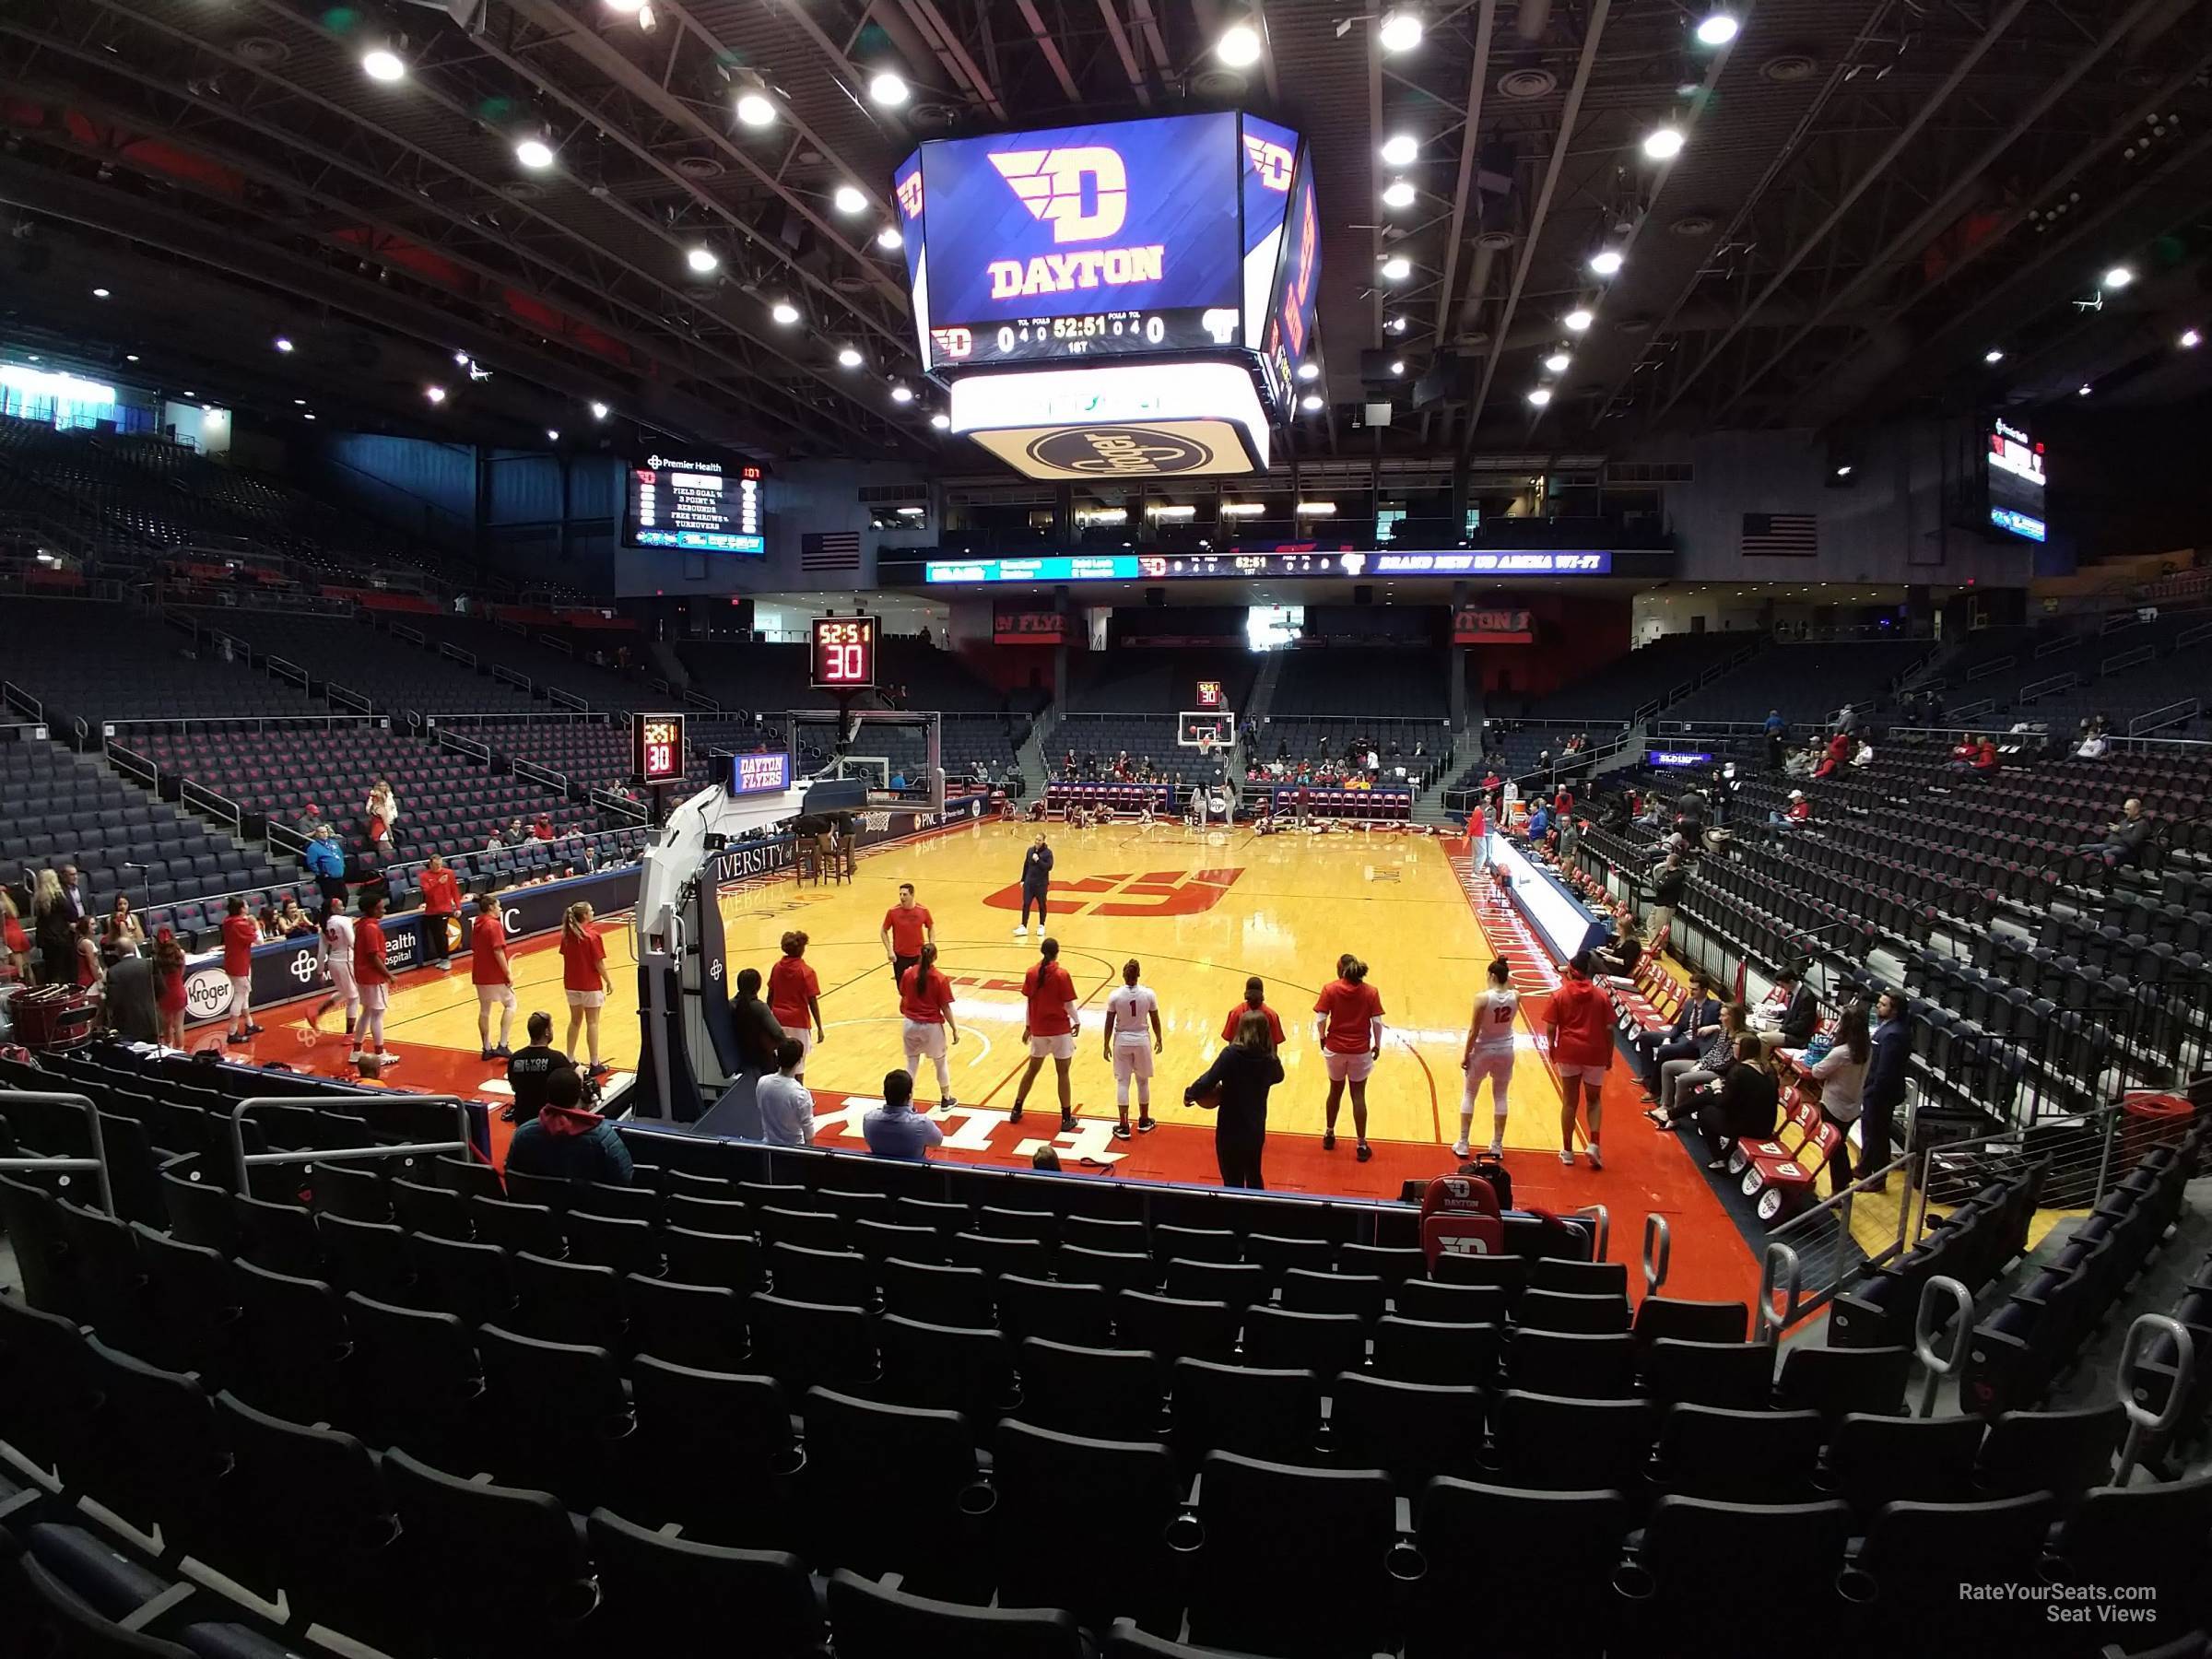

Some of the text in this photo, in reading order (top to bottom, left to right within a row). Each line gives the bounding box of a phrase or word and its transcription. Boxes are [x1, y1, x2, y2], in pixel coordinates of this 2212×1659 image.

[987, 147, 1126, 242] D
[987, 245, 1165, 300] DAYTON
[998, 327, 1015, 353] 0
[1019, 328, 1029, 342] 4
[1037, 326, 1047, 341] 0
[1053, 316, 1106, 338] 52:51
[1112, 321, 1123, 335] 0
[1130, 320, 1140, 335] 4
[1147, 317, 1165, 343] 0
[1068, 342, 1088, 353] 1ST
[663, 459, 722, 472] Premier Health
[673, 488, 695, 496] FIELD
[696, 488, 716, 498] GOAL
[677, 504, 717, 512] REBOUNDS
[671, 512, 691, 520] FREE
[692, 513, 724, 522] THROWS
[675, 521, 720, 530] TURNOVERS
[1208, 563, 1215, 572] 0
[1287, 561, 1293, 571] 0
[1378, 556, 1433, 570] BRAND
[1433, 556, 1473, 570] NEW
[1498, 555, 1553, 569] ARENA
[819, 624, 869, 643] 52:51
[827, 645, 862, 677] 30
[1202, 691, 1215, 702] 30
[650, 746, 669, 771] 30
[740, 757, 782, 773] DAYTON
[742, 772, 782, 789] FLYERS
[922, 813, 936, 828] PNC
[1485, 925, 1563, 997] DAYTON
[188, 978, 229, 1010] Kroger
[1129, 999, 1136, 1018] 1
[1494, 1006, 1512, 1024] 12
[1444, 1199, 1479, 1208] DAYTON
